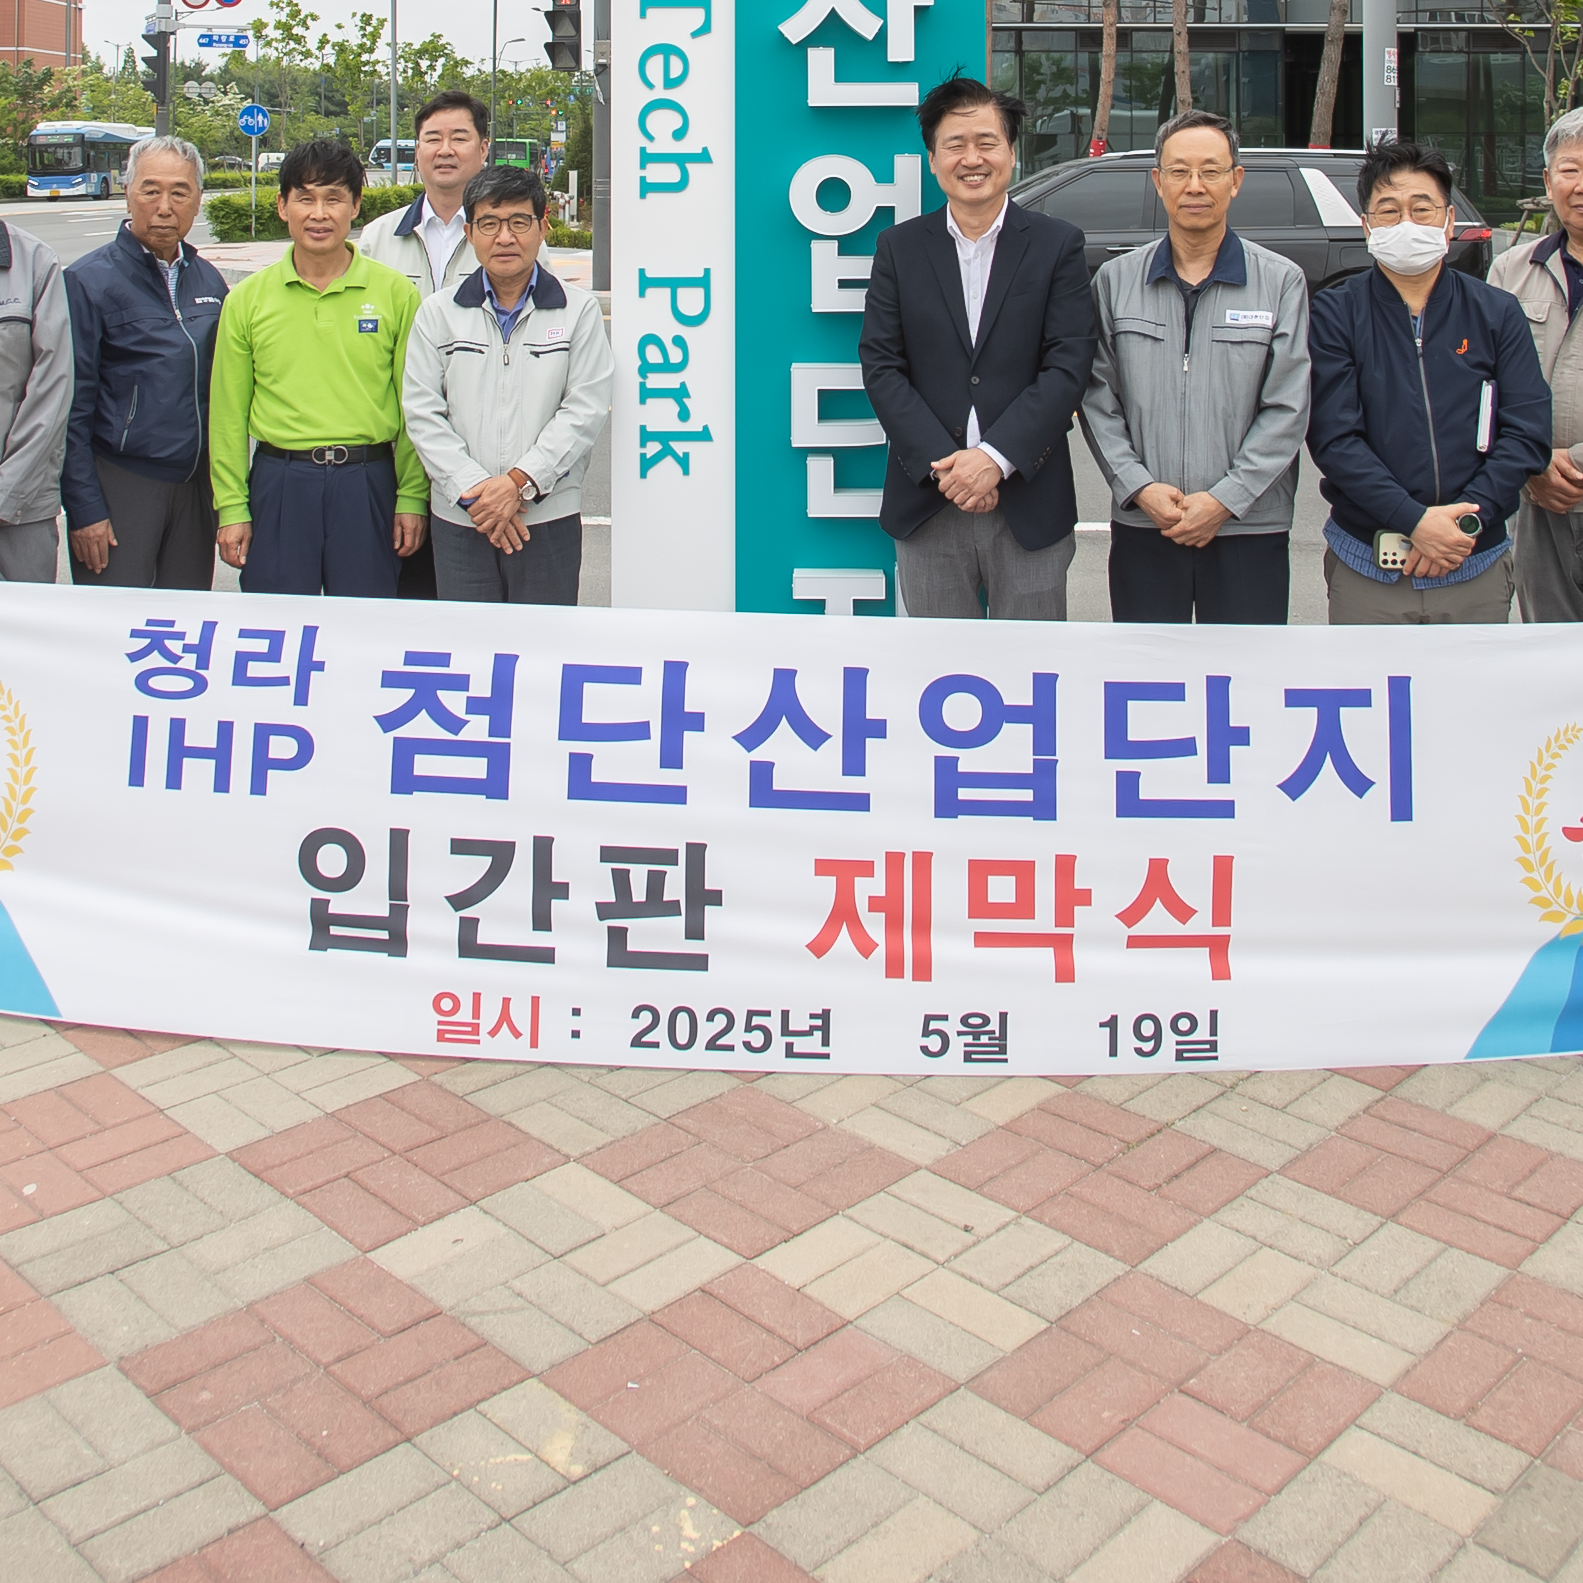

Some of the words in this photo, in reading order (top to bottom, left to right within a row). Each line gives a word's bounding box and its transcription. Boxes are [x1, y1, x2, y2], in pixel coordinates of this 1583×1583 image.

[636, 267, 714, 480] Park
[124, 617, 327, 709] 청라
[126, 714, 317, 797] IHP
[373, 650, 1415, 823] 첨단산업단지
[296, 825, 724, 973] 입간판
[804, 850, 1236, 985] 제막식
[431, 990, 542, 1050] 일시
[629, 1002, 834, 1061] 2025년
[918, 1009, 1011, 1065] 5월
[1097, 1007, 1222, 1064] 19일
